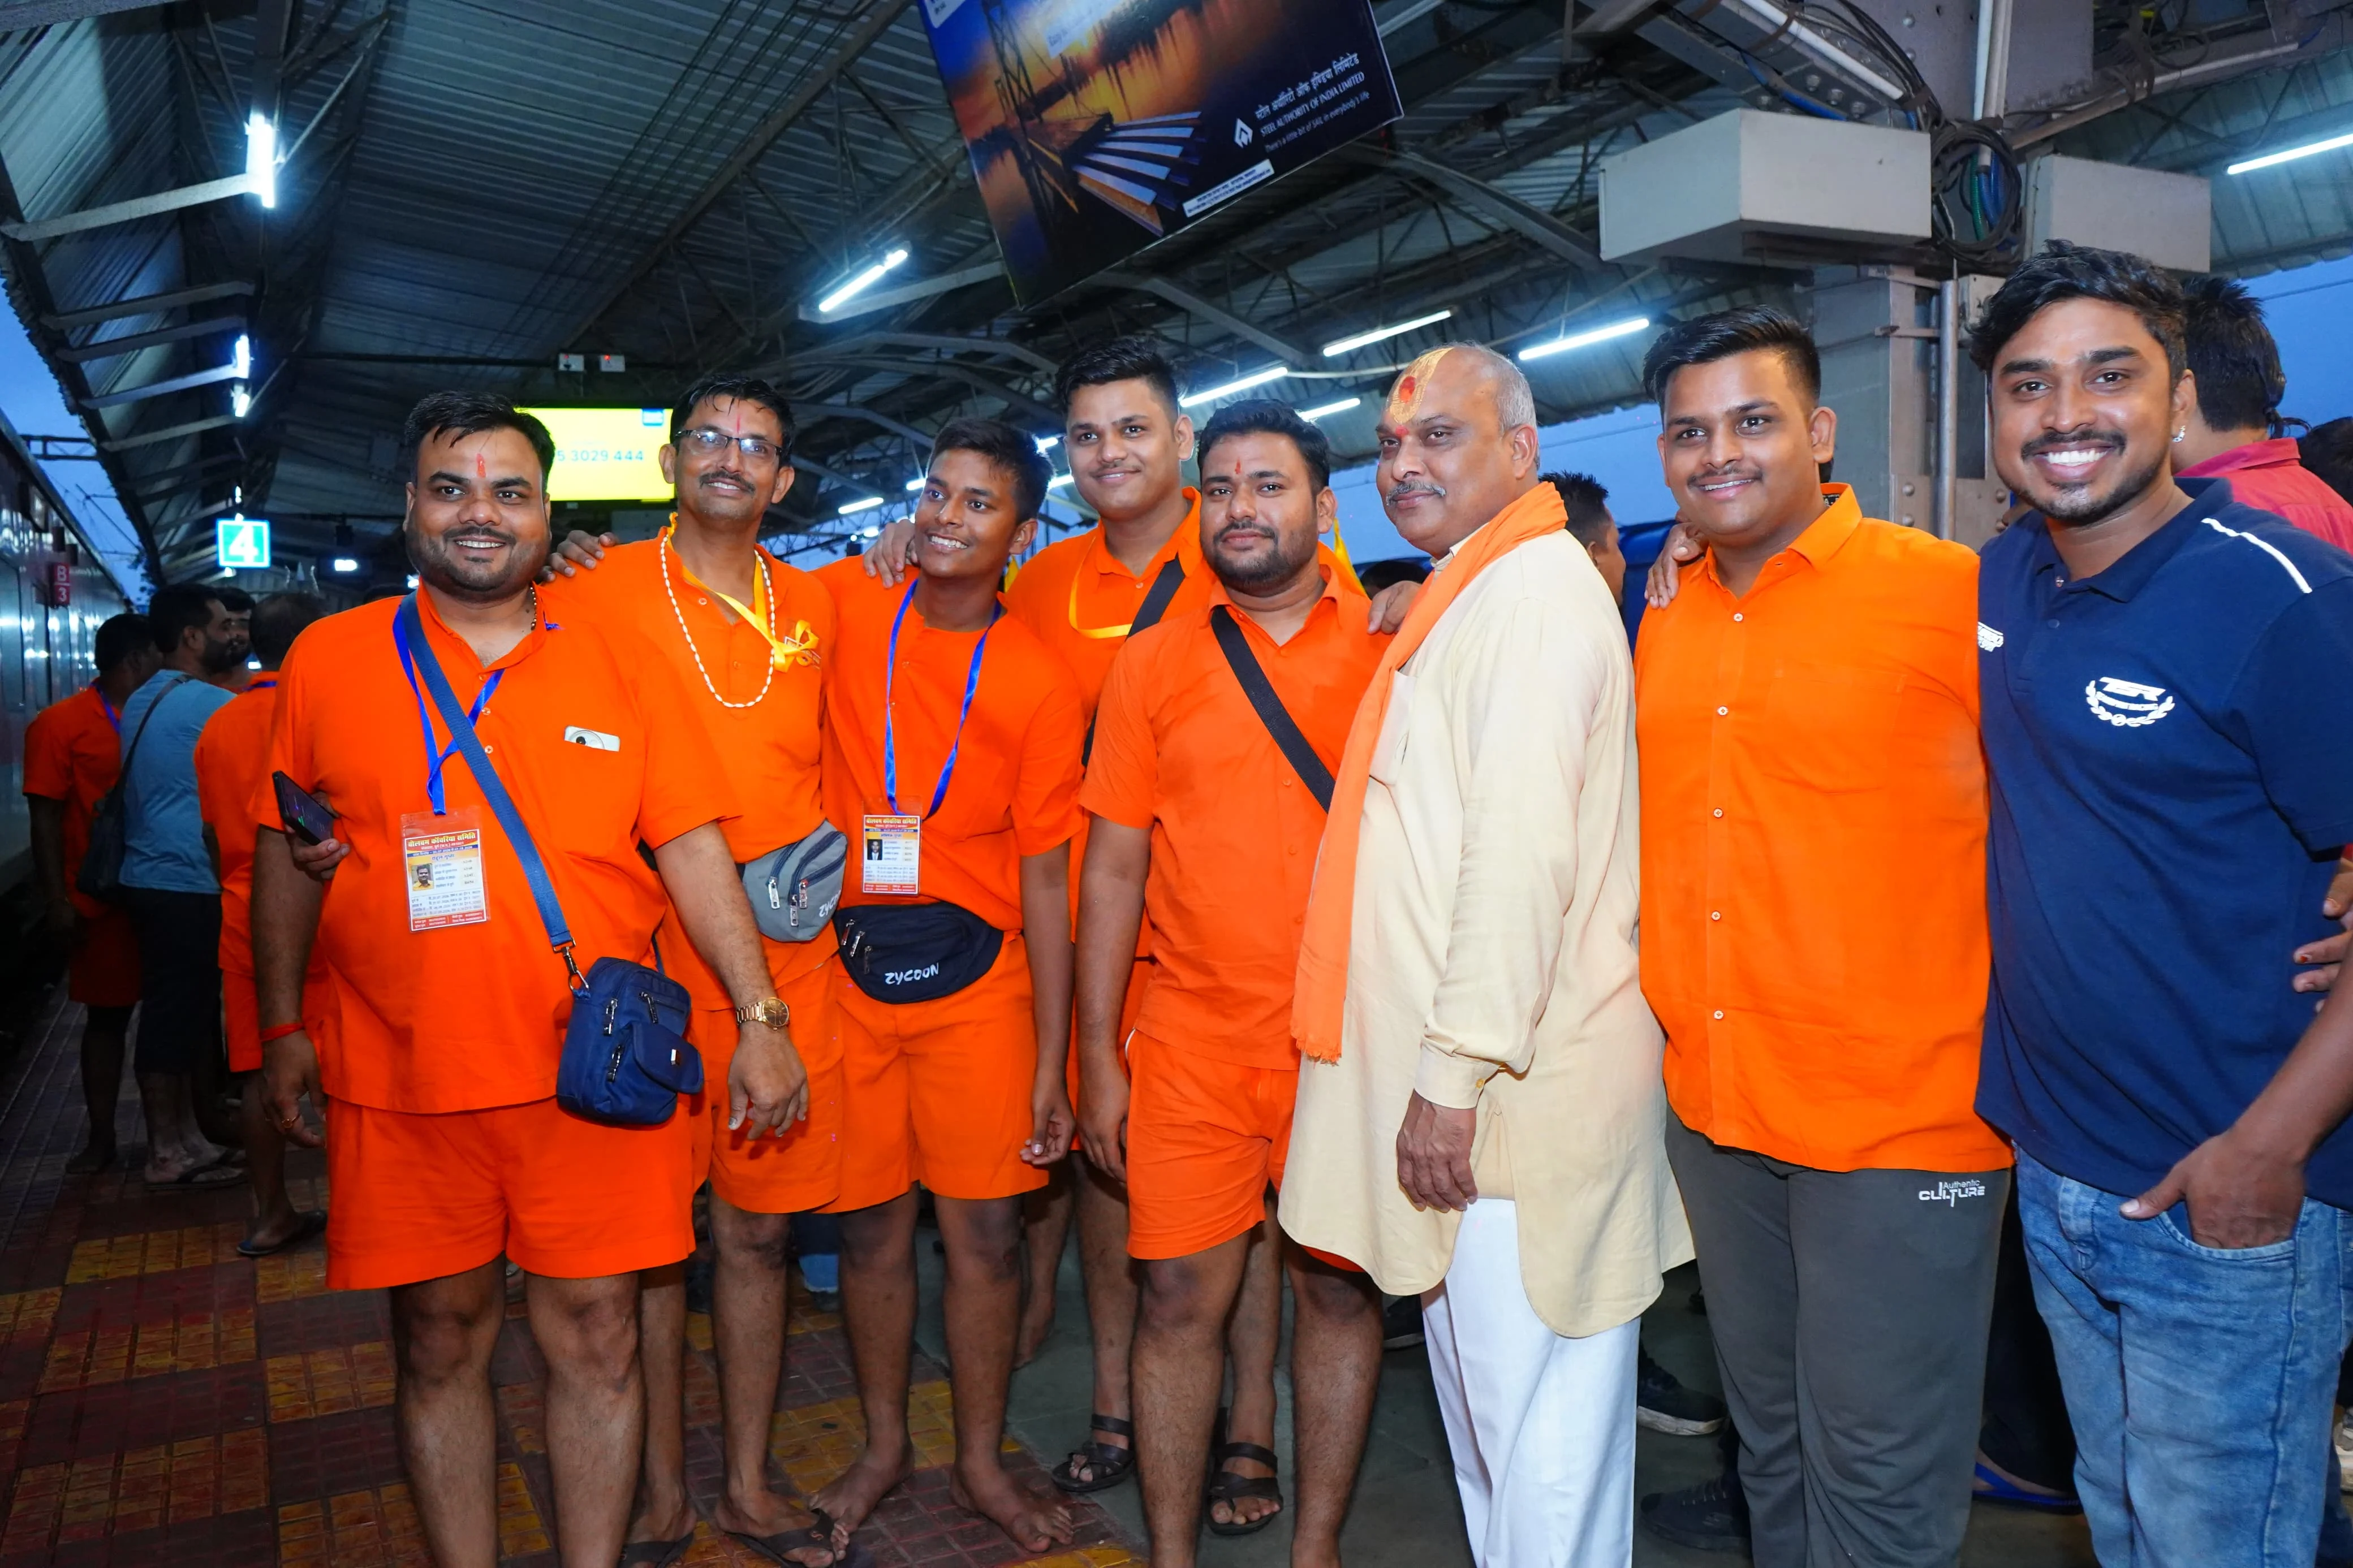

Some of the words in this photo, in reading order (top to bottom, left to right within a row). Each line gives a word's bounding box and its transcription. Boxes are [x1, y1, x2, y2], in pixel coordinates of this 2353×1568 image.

[1260, 122, 1277, 137] STEEL
[1276, 103, 1310, 128] AUTHORITY
[1309, 97, 1320, 109] OF
[1318, 86, 1339, 104] INDIA
[1338, 71, 1365, 93] LIMITED
[1305, 122, 1312, 132] of
[1359, 91, 1371, 102] life
[571, 450, 609, 461] 3029
[613, 451, 644, 461] 444
[229, 524, 259, 565] 4
[57, 565, 67, 582] B
[58, 587, 67, 602] 3
[456, 832, 476, 841] समिति
[885, 962, 939, 985] ZYCOON
[1919, 1181, 1985, 1208] CULTURE
[1942, 1179, 1981, 1190] Authentic
